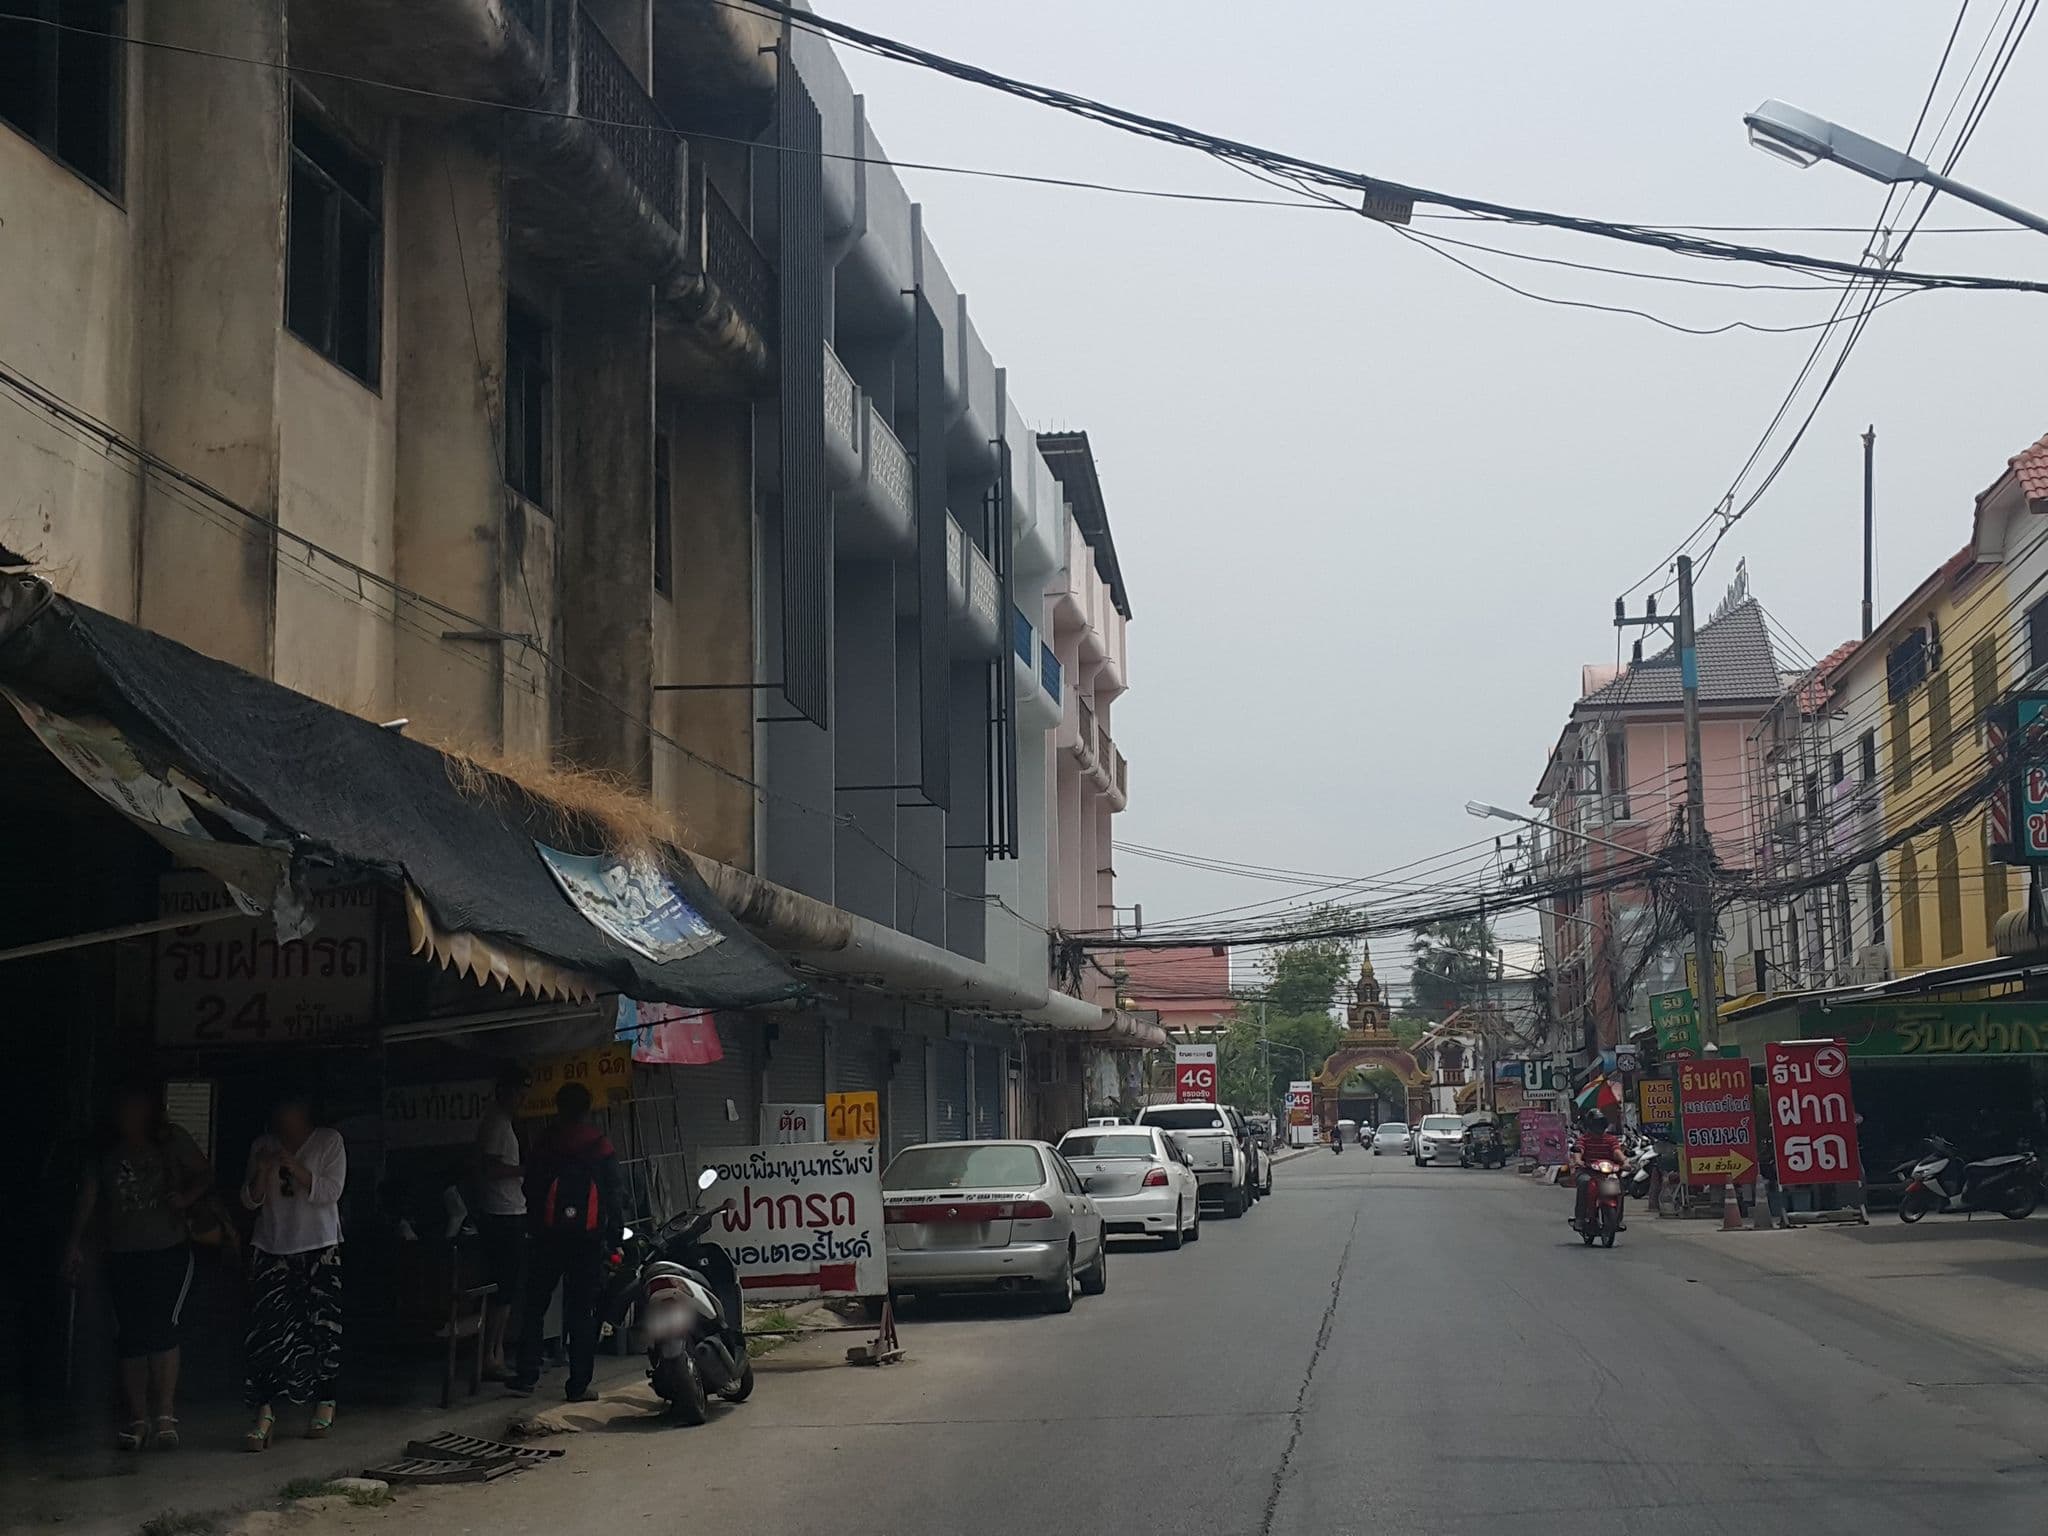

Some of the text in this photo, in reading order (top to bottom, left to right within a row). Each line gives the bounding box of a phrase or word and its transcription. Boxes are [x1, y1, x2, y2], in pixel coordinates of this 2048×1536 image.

[196, 993, 271, 1040] 24
[1180, 1069, 1212, 1087] 4G
[1682, 1065, 1744, 1091] รับฝาก
[1772, 1054, 1812, 1084] รับ
[1295, 1094, 1311, 1105] 4G
[1777, 1088, 1848, 1126] ฝาก
[779, 1109, 806, 1132] ตัด
[830, 1095, 876, 1137] ว่าง
[1687, 1116, 1750, 1147] รถยนต์
[1698, 1163, 1711, 1172] 24
[1783, 1133, 1848, 1172] รถ
[721, 1186, 856, 1233] ฝากรถ
